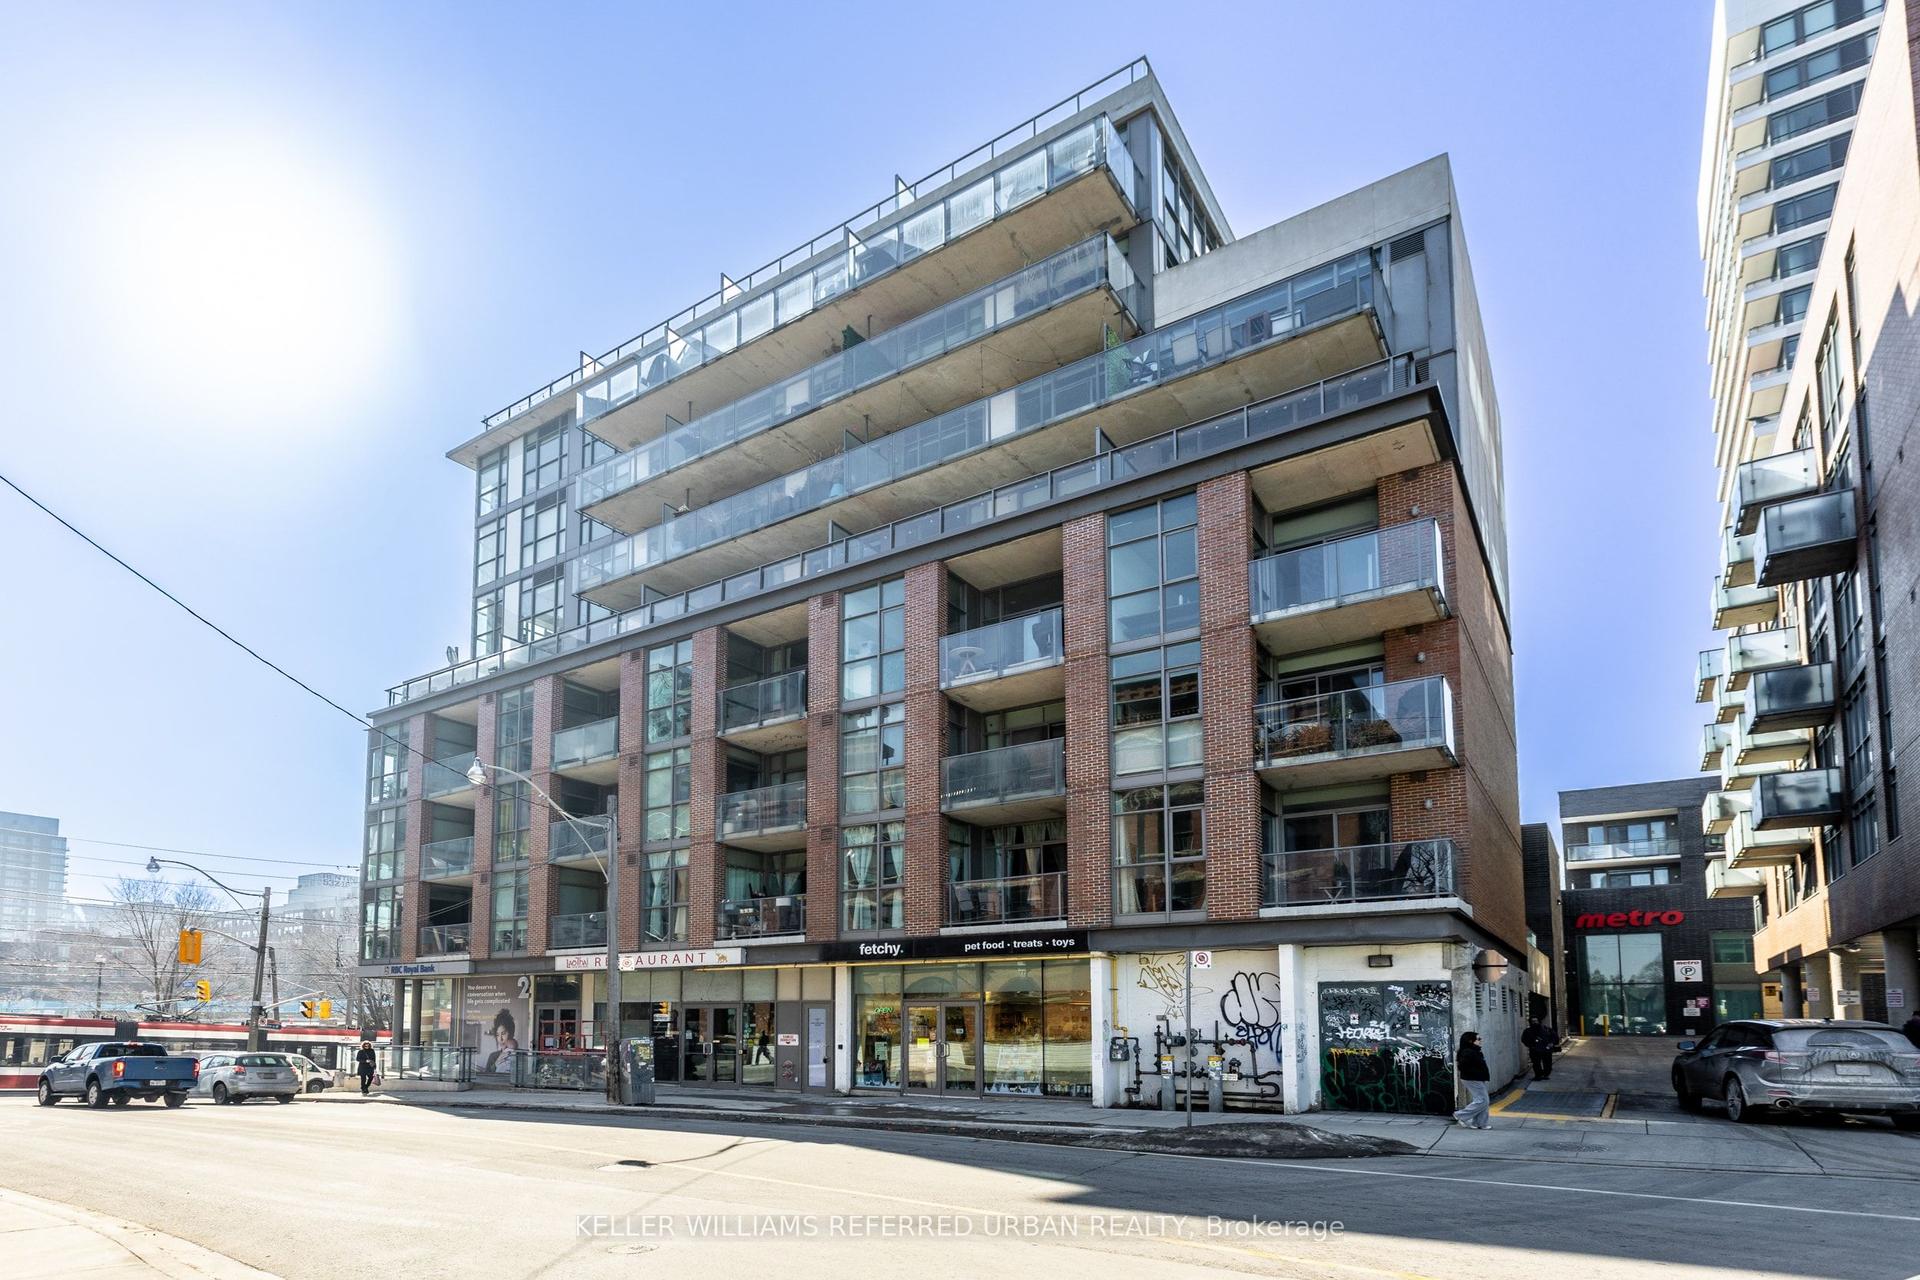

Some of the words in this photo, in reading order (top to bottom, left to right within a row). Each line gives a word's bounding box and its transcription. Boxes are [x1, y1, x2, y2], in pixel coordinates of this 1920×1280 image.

[1575, 908, 1684, 928] metro
[859, 942, 904, 956] fetchy.
[964, 942, 980, 953] pet
[982, 941, 1005, 950] food
[1013, 939, 1043, 949] treats
[1052, 938, 1075, 949] toys
[390, 965, 402, 974] RBC
[403, 964, 419, 975] Royal
[420, 964, 435, 972] Bank
[517, 976, 529, 998] 2
